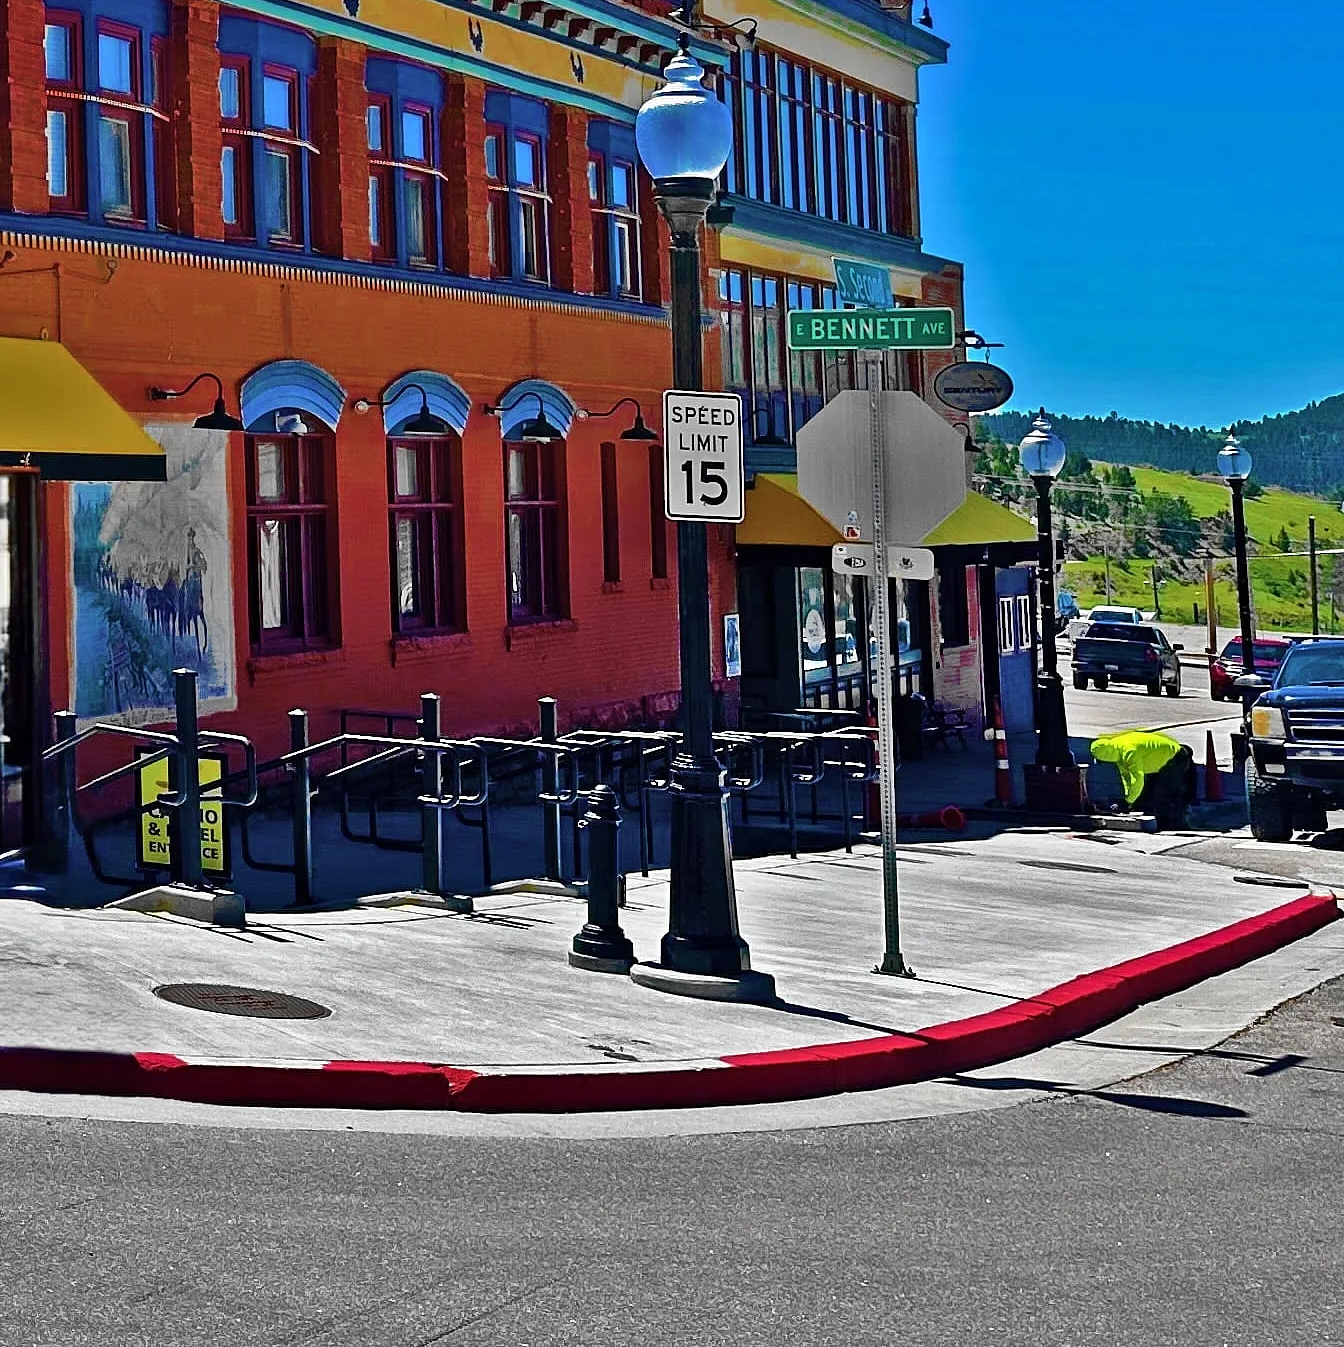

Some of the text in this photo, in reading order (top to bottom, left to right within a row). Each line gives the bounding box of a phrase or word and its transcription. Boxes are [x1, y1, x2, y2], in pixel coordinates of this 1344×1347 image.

[796, 317, 945, 340] E BENNETT AVE
[672, 406, 735, 426] SPEED
[679, 433, 729, 453] LIMIT
[681, 459, 729, 506] 15
[149, 841, 219, 859] ENCE
